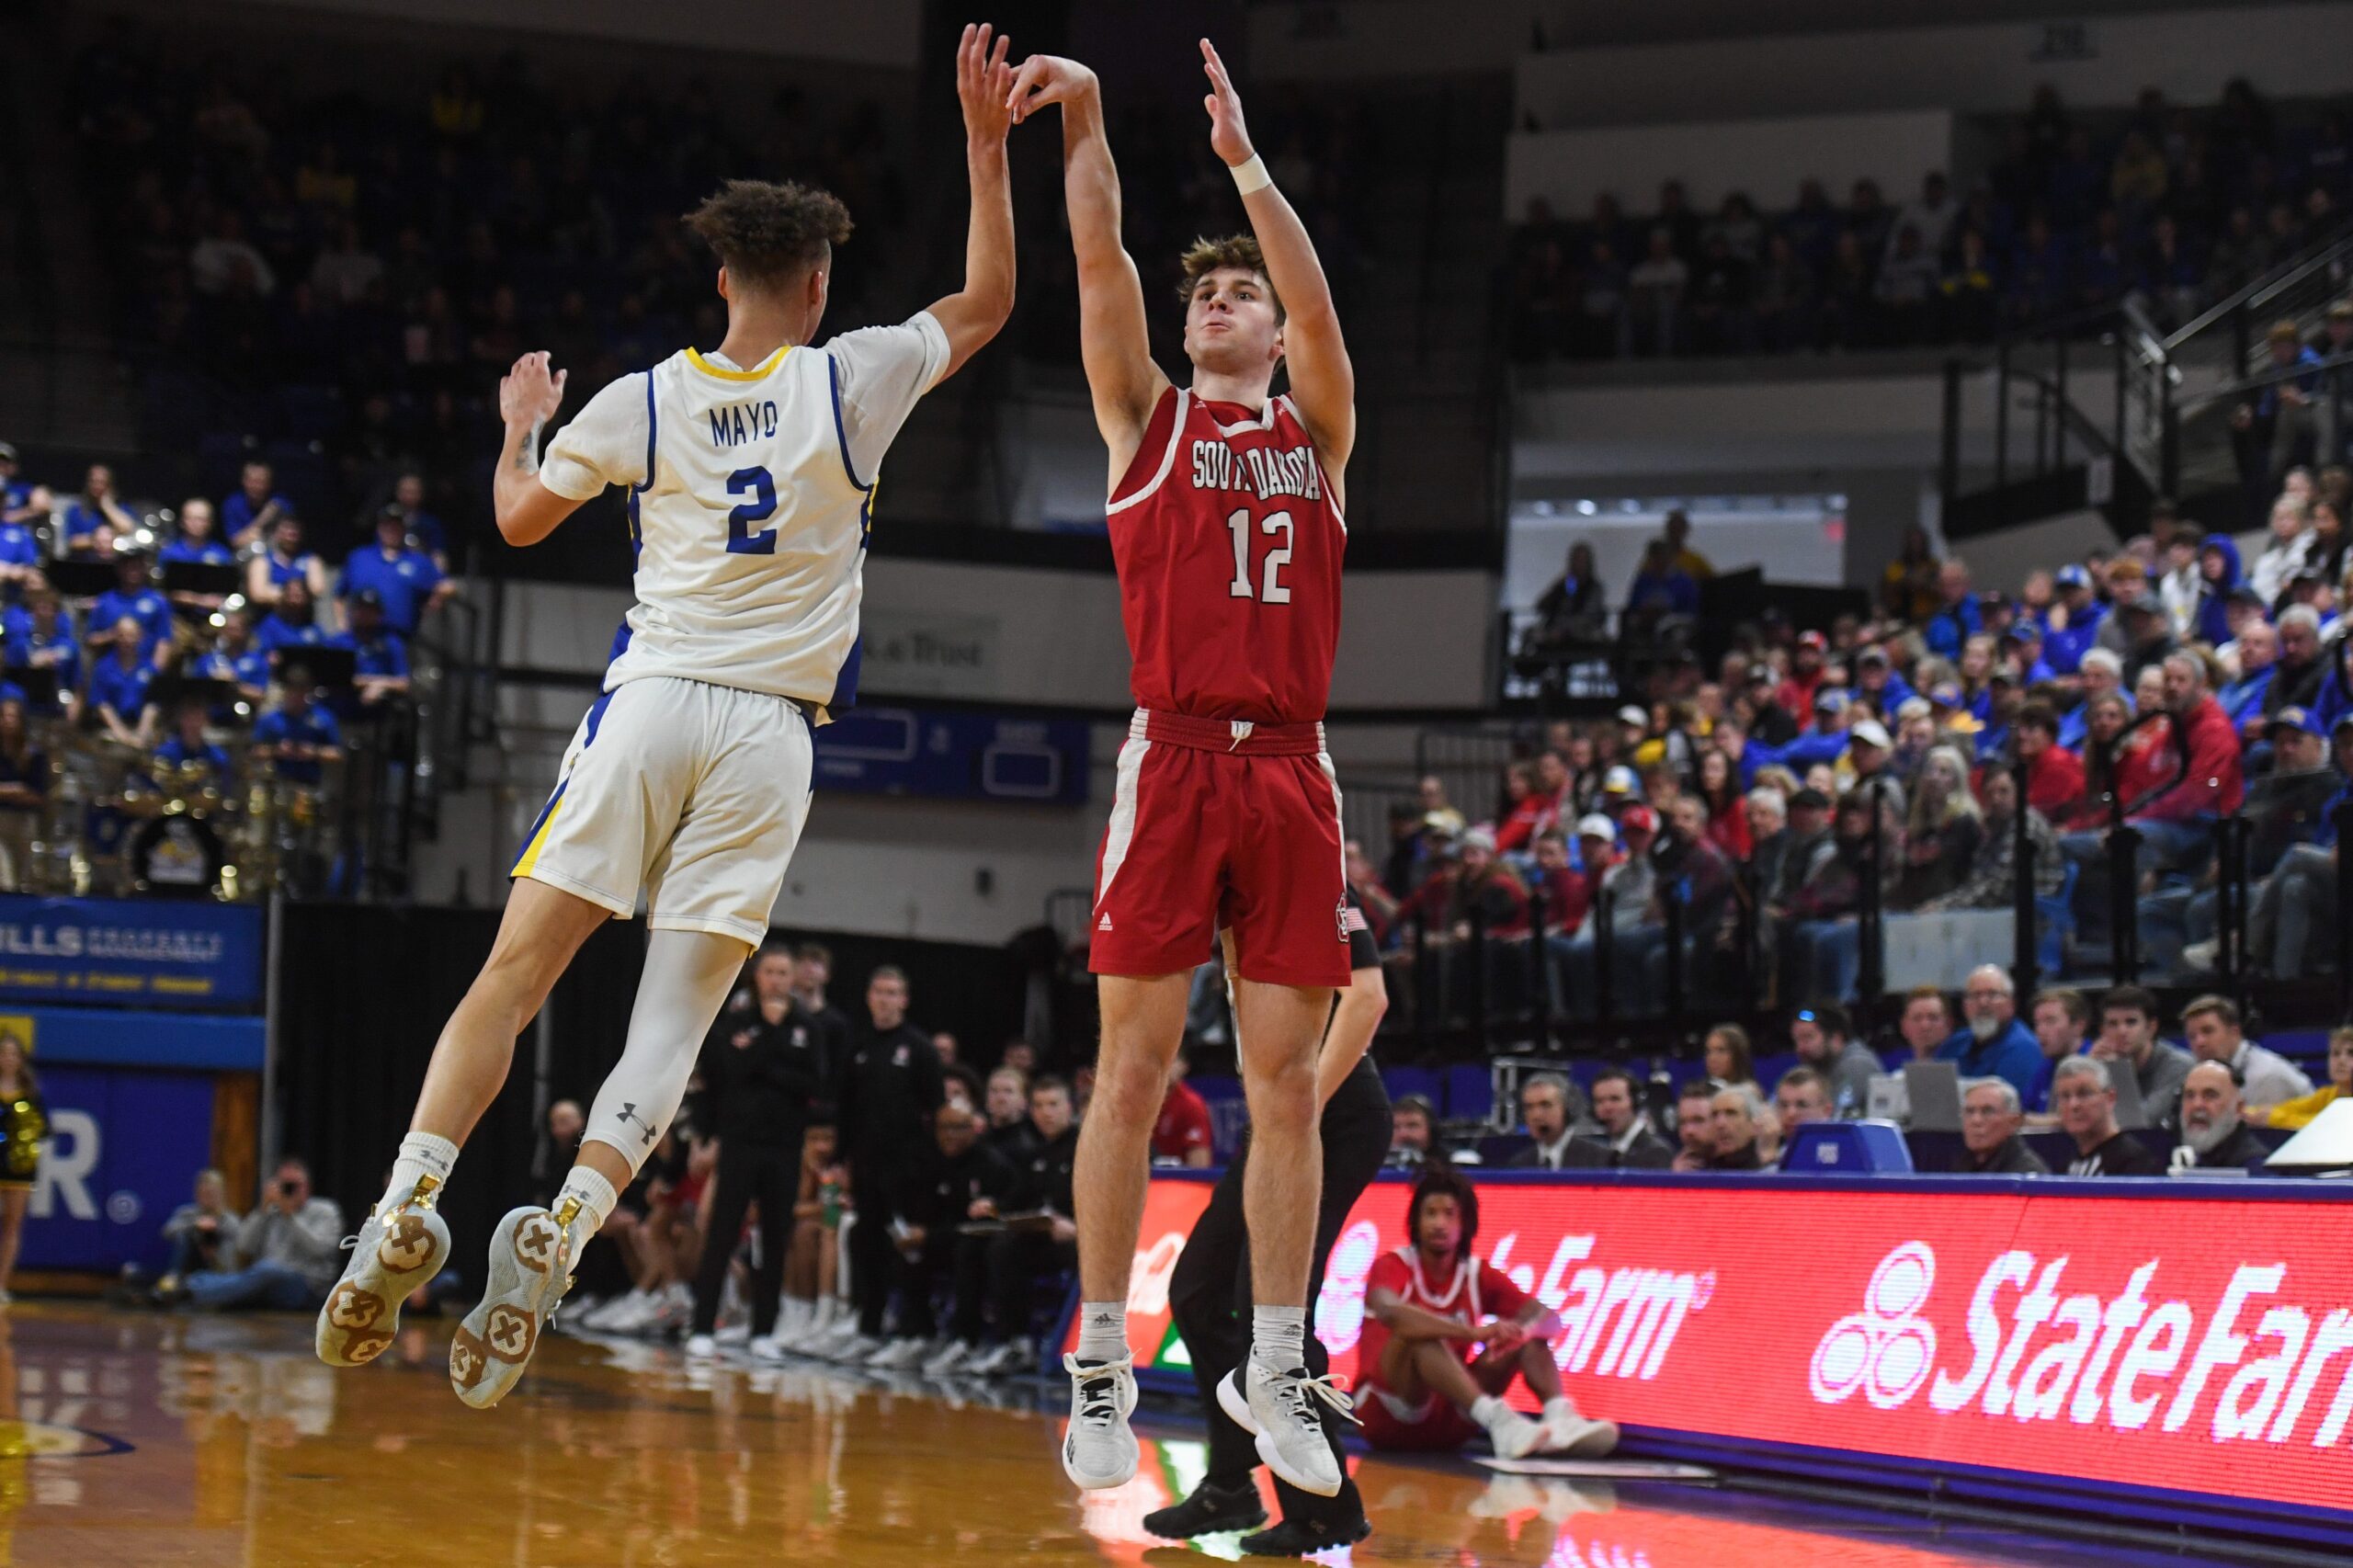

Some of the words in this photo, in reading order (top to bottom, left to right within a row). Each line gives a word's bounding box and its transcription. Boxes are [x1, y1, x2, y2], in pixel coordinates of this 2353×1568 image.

[709, 401, 778, 447] MAYO
[725, 465, 778, 554] 2
[1227, 508, 1294, 604] 12
